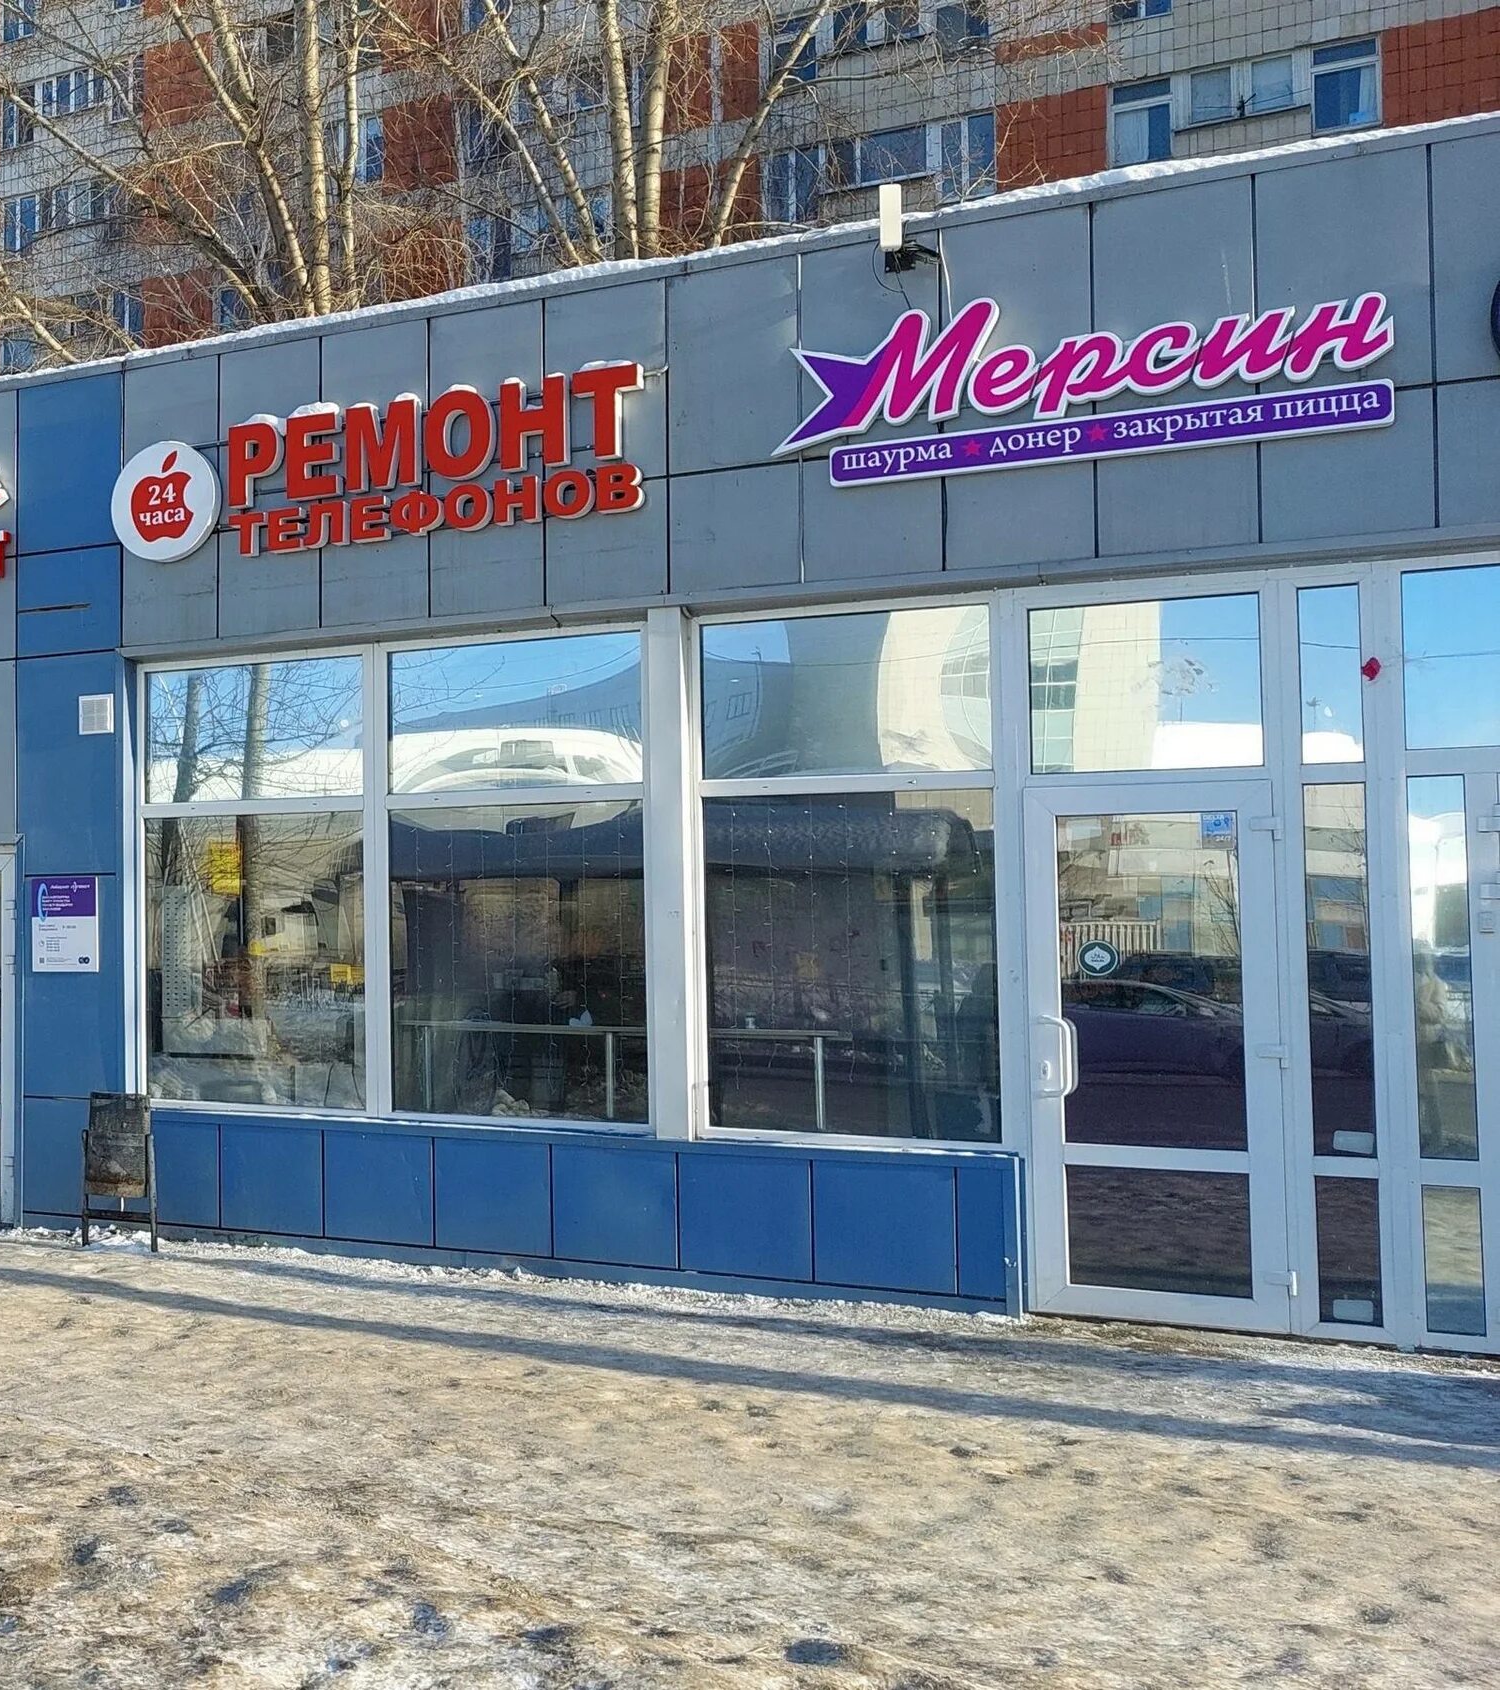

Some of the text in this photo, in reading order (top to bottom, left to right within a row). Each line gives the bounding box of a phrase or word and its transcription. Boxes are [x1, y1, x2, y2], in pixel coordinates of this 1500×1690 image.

[838, 294, 1394, 426] Мерсин
[228, 363, 644, 508] РЕМОНТ
[842, 388, 1381, 474] шаурма донер закрытая пицца
[139, 507, 186, 527] часа
[148, 482, 177, 506] 24
[228, 463, 645, 556] ТЕЛЕФОНОВ
